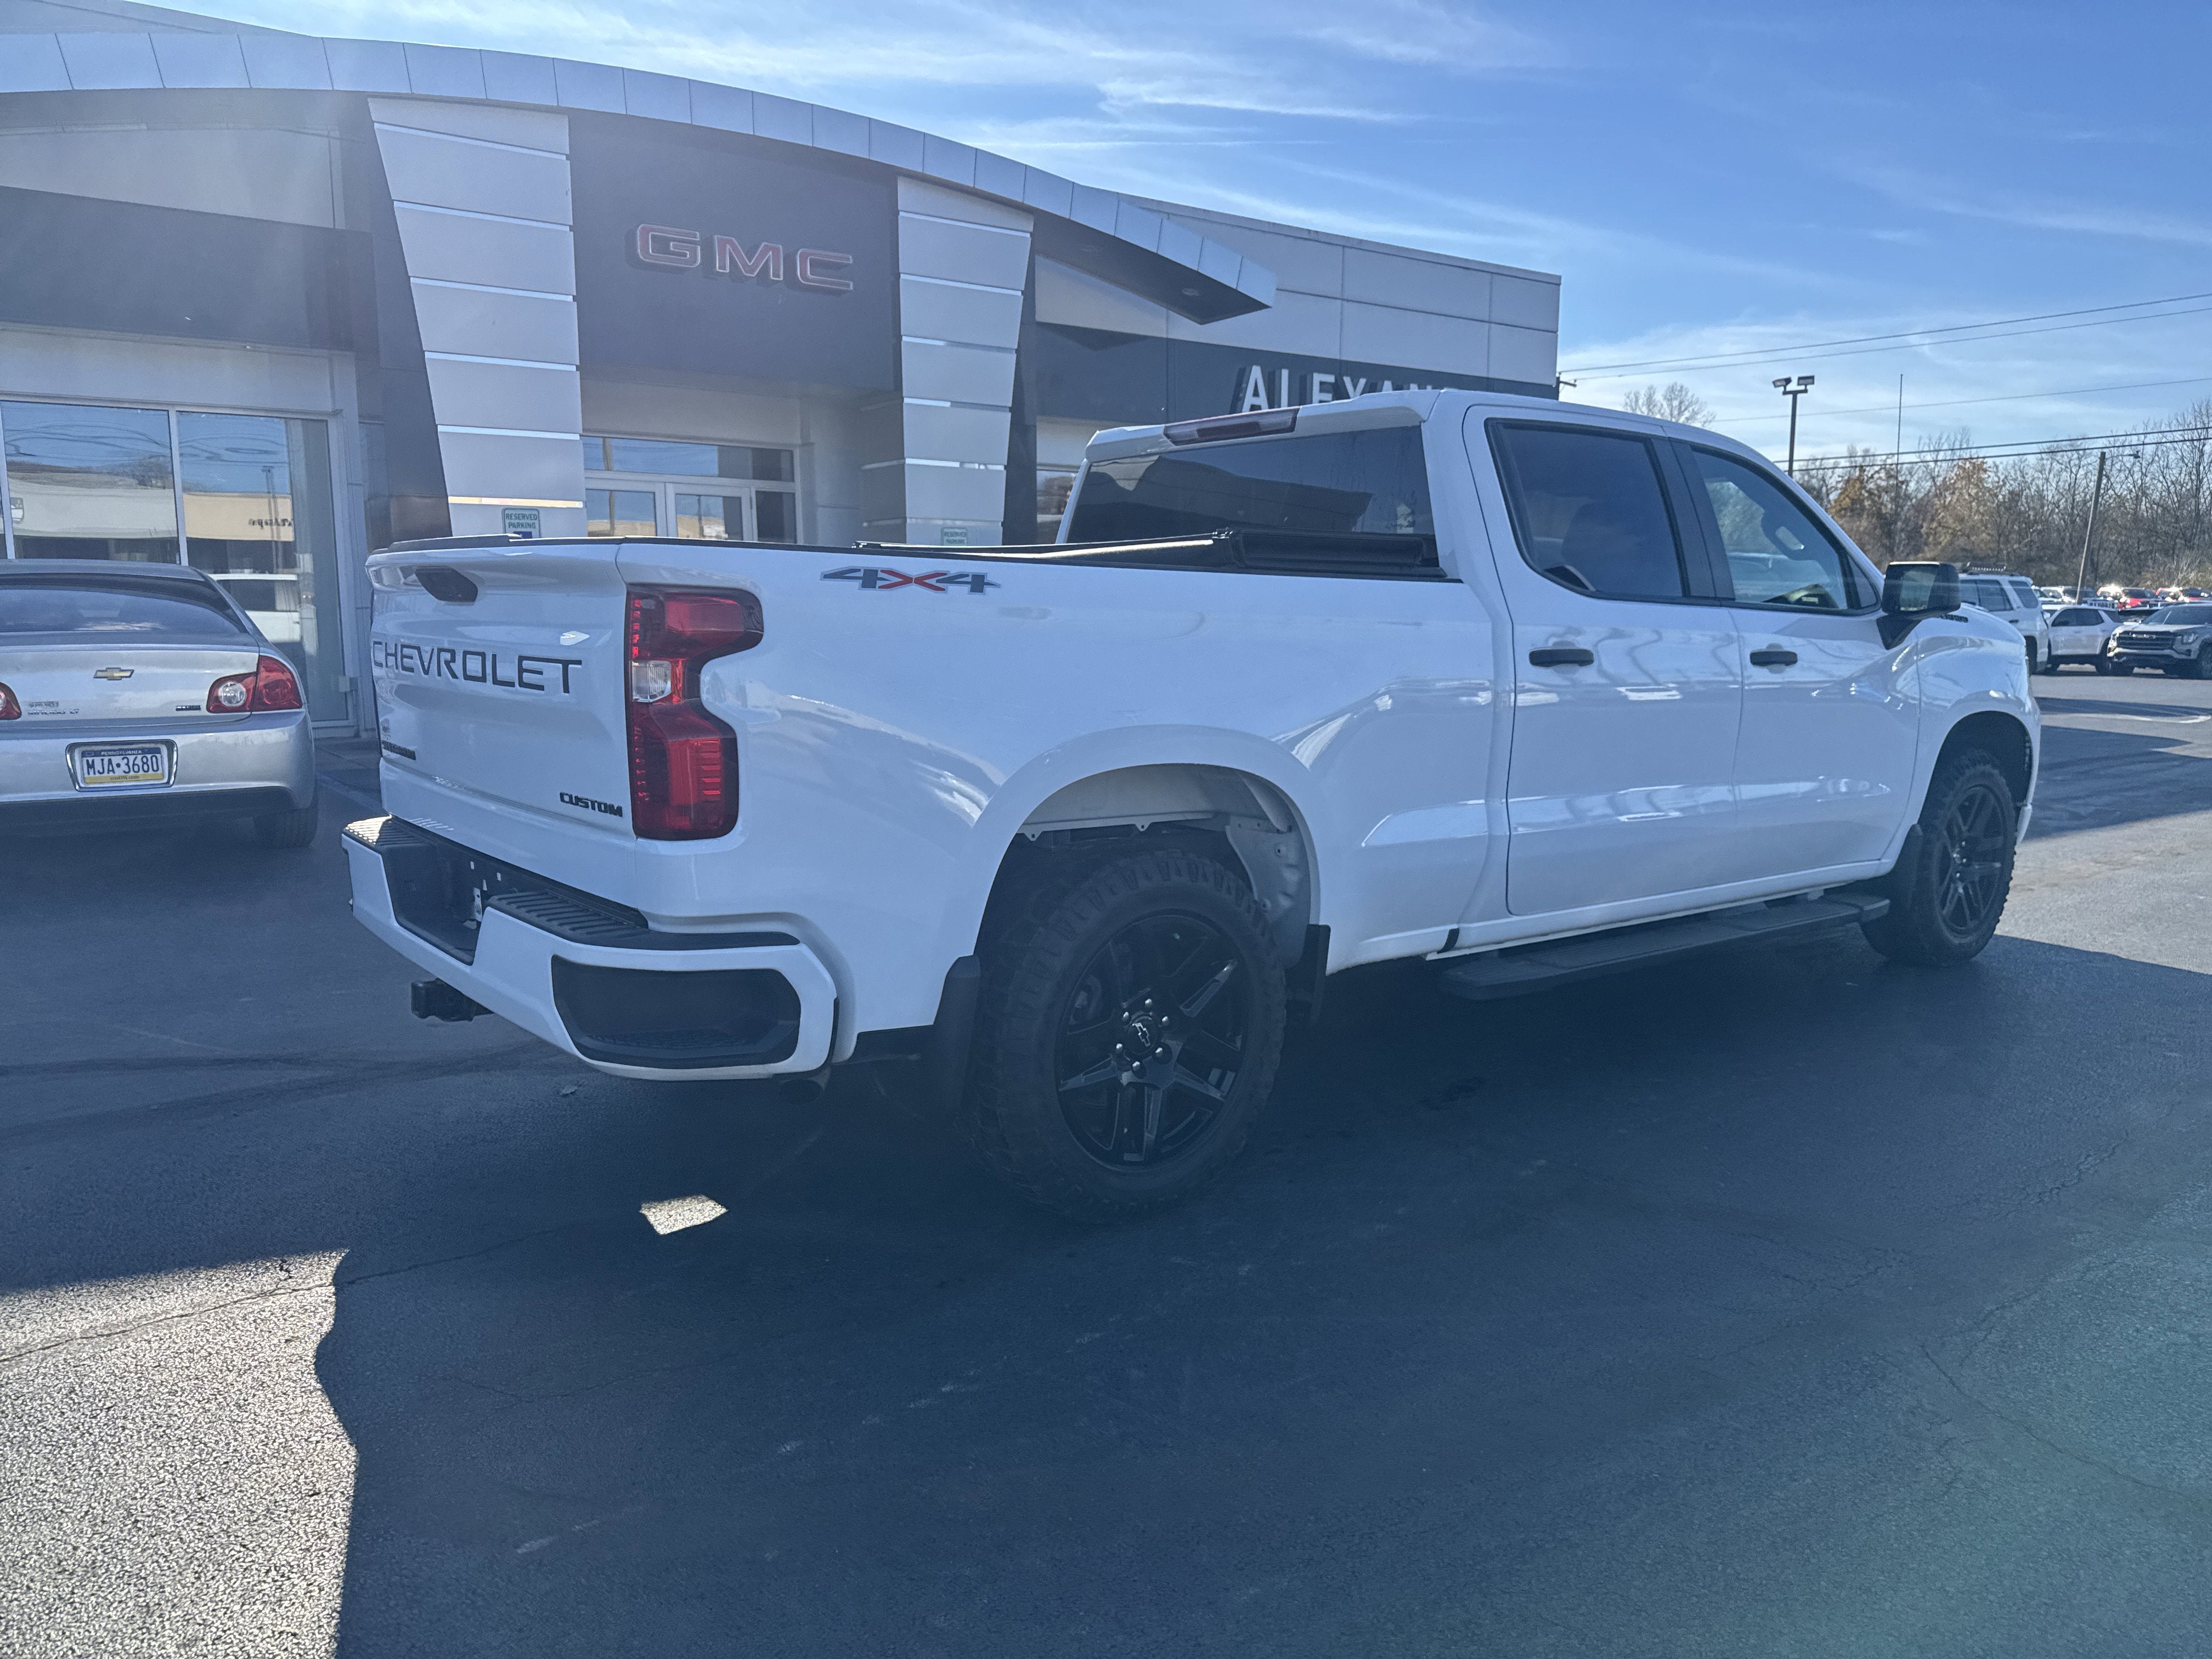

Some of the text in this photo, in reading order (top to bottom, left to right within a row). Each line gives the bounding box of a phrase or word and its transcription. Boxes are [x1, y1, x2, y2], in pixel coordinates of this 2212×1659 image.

[637, 223, 854, 290] GMC
[373, 640, 582, 694] CHEVROLET
[560, 792, 623, 817] CUSTOM
